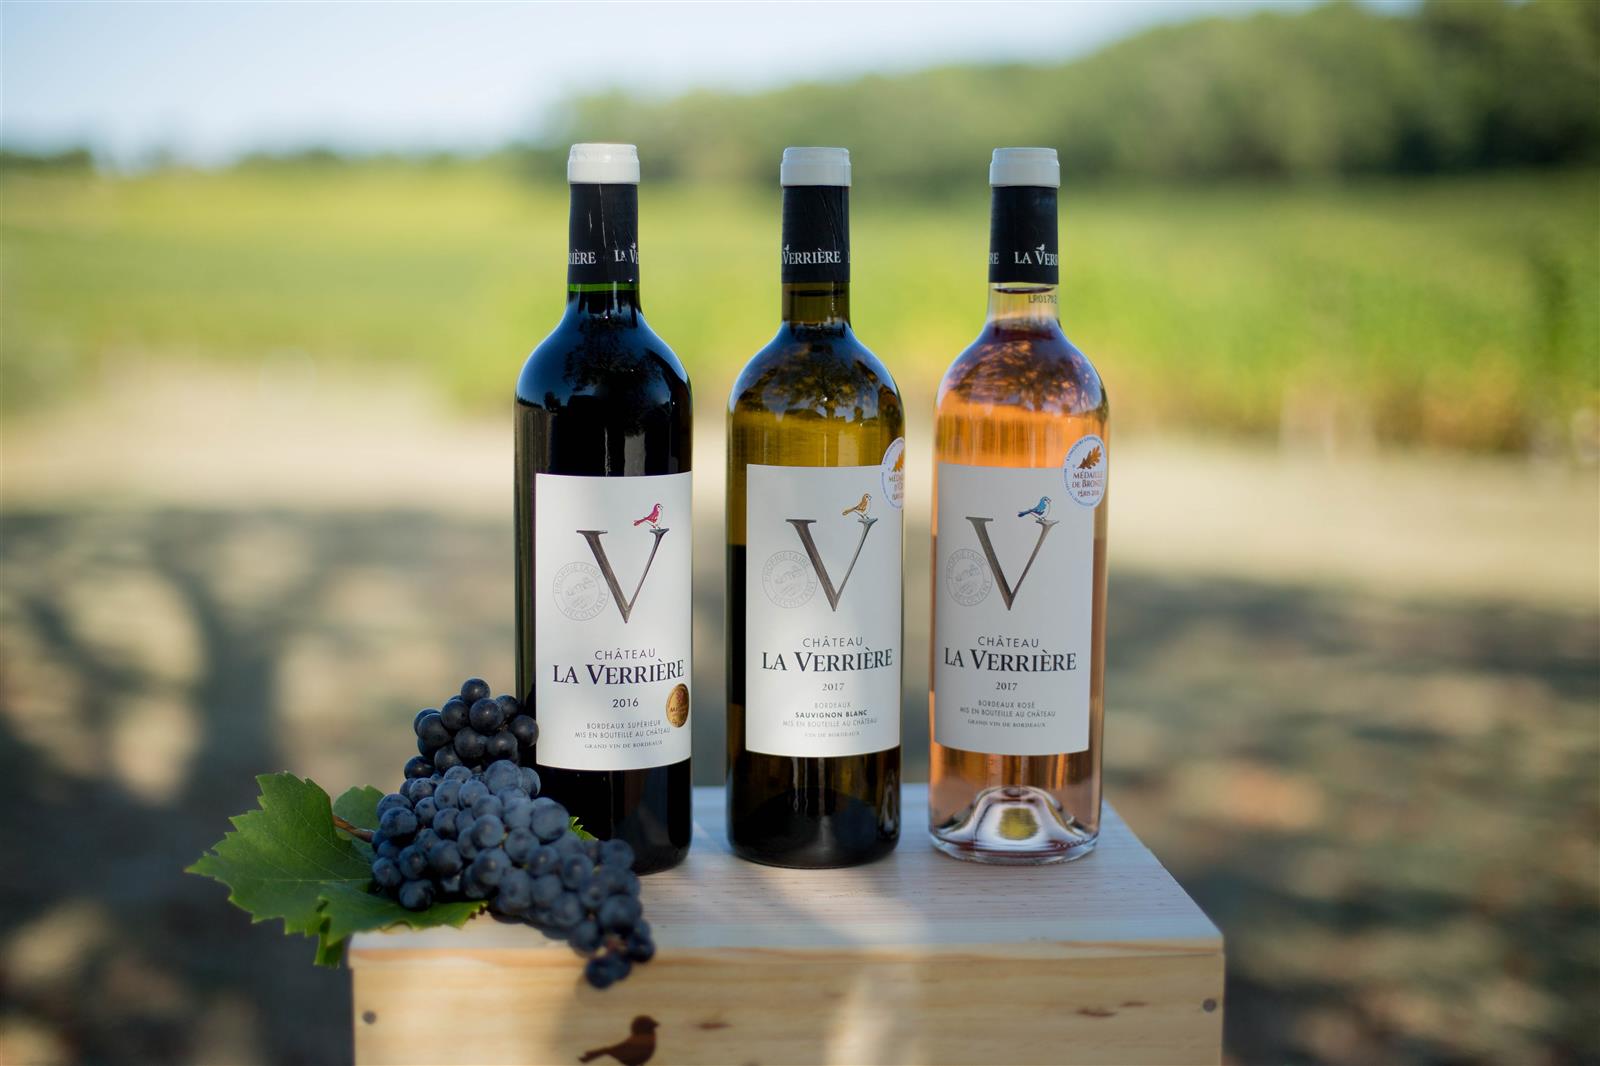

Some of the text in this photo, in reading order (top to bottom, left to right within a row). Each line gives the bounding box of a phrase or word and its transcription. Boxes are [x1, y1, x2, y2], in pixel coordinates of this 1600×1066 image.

[614, 250, 626, 262] LA
[1014, 252, 1032, 264] LA
[802, 636, 864, 648] CHÂTEAU
[978, 635, 1040, 648] CHÂTEAU
[594, 648, 656, 660] CHÂTEAU
[762, 647, 893, 672] LA VERRIÈRE
[944, 648, 1077, 672] LA VERRIÈRE
[552, 659, 684, 685] LA VERRIÈRE
[822, 682, 845, 692] 2017
[995, 682, 1018, 691] 2017
[612, 697, 639, 708] 2016
[814, 702, 851, 710] BORDEAUX
[978, 700, 1036, 709] BORDEAUX ROSÉ
[795, 710, 868, 719] SAUVIGNON BLANC
[960, 706, 970, 714] MIS
[981, 709, 1014, 717] BOUTEILLE
[1015, 710, 1025, 718] AU
[1026, 710, 1056, 718] CHÂTEAU
[586, 719, 662, 730] BORDEAUX SUPÉRIEUR
[796, 720, 806, 728] EN
[807, 720, 840, 728] BOUTEILLE
[852, 716, 878, 726] CHÂTEAU
[600, 731, 632, 739] BOUTEILLE
[635, 730, 644, 738] AU
[646, 726, 670, 736] CHÂTEAU
[633, 740, 663, 748] BORDEAUX
